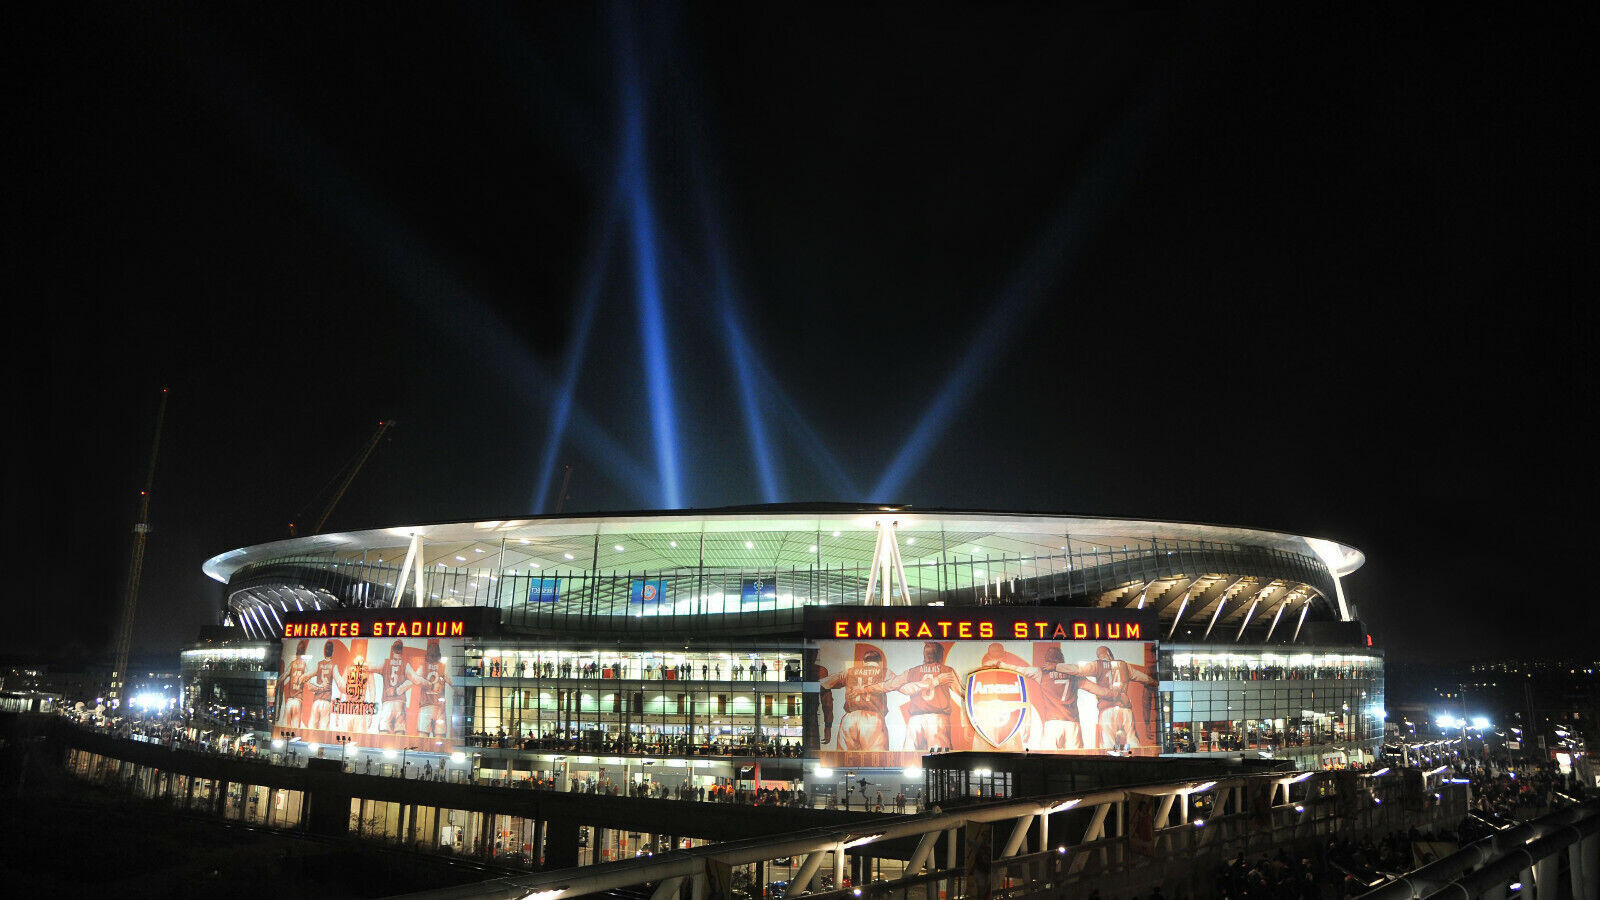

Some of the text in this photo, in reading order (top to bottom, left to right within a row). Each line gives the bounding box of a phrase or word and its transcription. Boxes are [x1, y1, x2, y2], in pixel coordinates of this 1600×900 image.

[285, 621, 463, 637] EMIRATES STADIUM
[835, 621, 1140, 638] EMIRATES STADIUM
[390, 666, 399, 686] 5
[974, 681, 1020, 694] Arsenal
[1054, 679, 1070, 701] 7
[331, 698, 376, 715] Emirates
